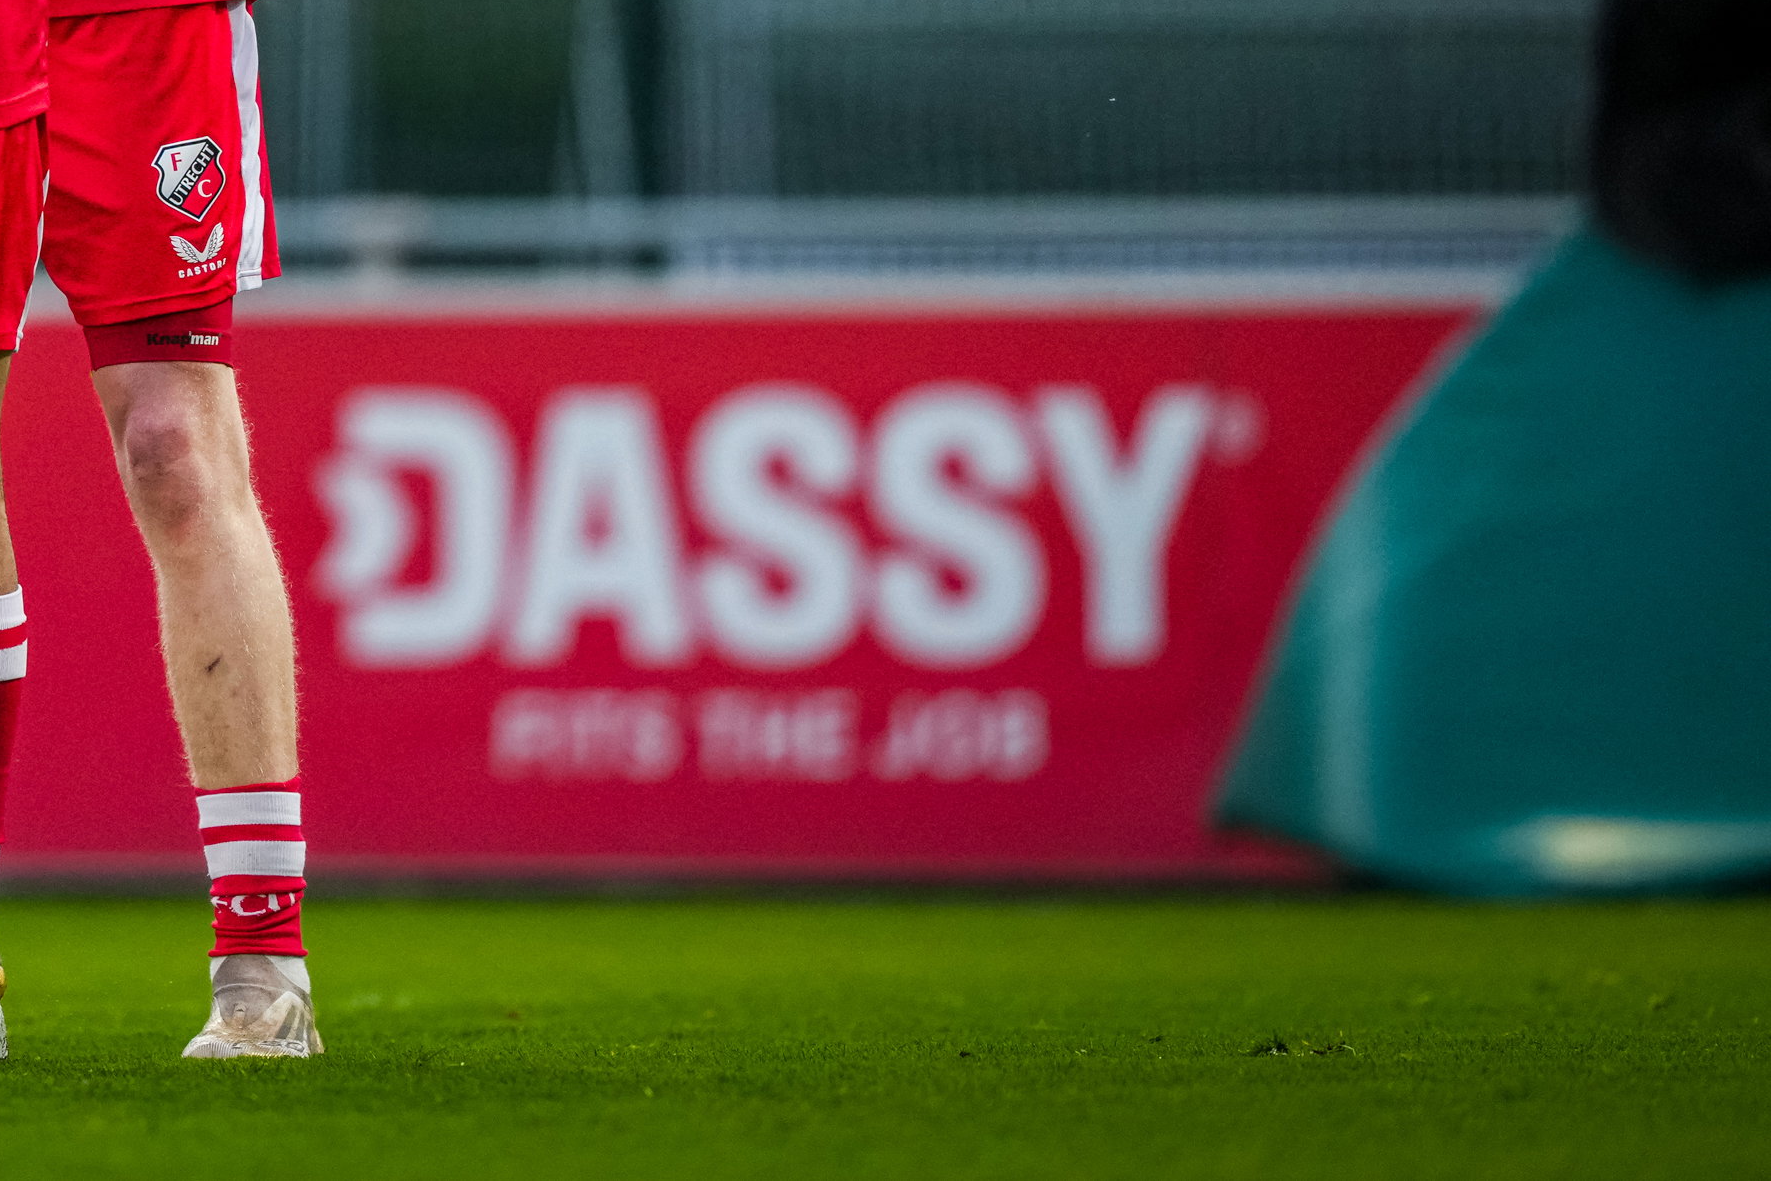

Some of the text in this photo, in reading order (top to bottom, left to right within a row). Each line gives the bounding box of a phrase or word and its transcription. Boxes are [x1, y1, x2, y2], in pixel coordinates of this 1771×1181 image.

[168, 143, 216, 208] UTRECHT
[170, 151, 183, 172] F
[197, 178, 213, 199] C
[312, 382, 1216, 669] DASSY
